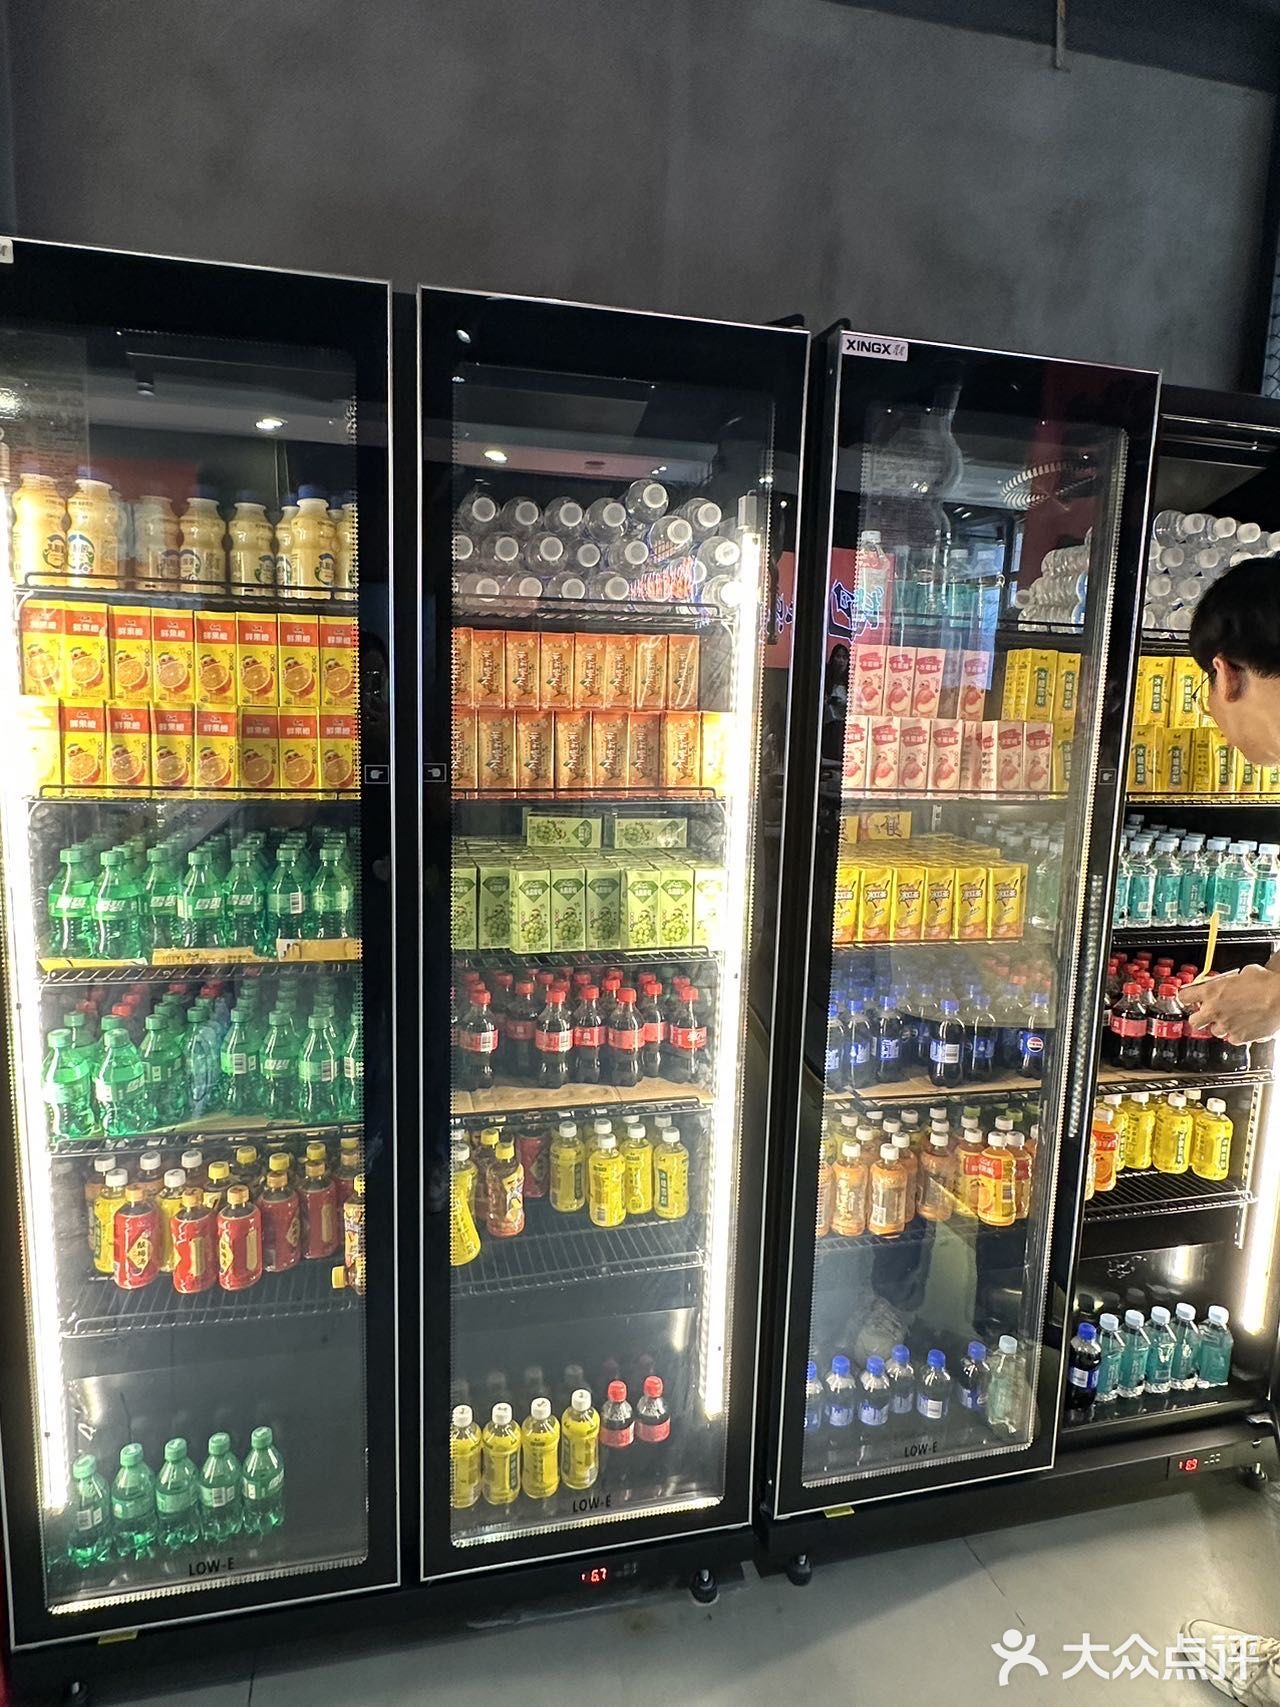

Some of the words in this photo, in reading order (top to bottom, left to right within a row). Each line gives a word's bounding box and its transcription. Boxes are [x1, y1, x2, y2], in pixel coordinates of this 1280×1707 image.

[846, 339, 891, 355] XINGX
[904, 1443, 938, 1458] LOW-E
[572, 1494, 612, 1514] LOW-E
[188, 1557, 236, 1577] LOW-E
